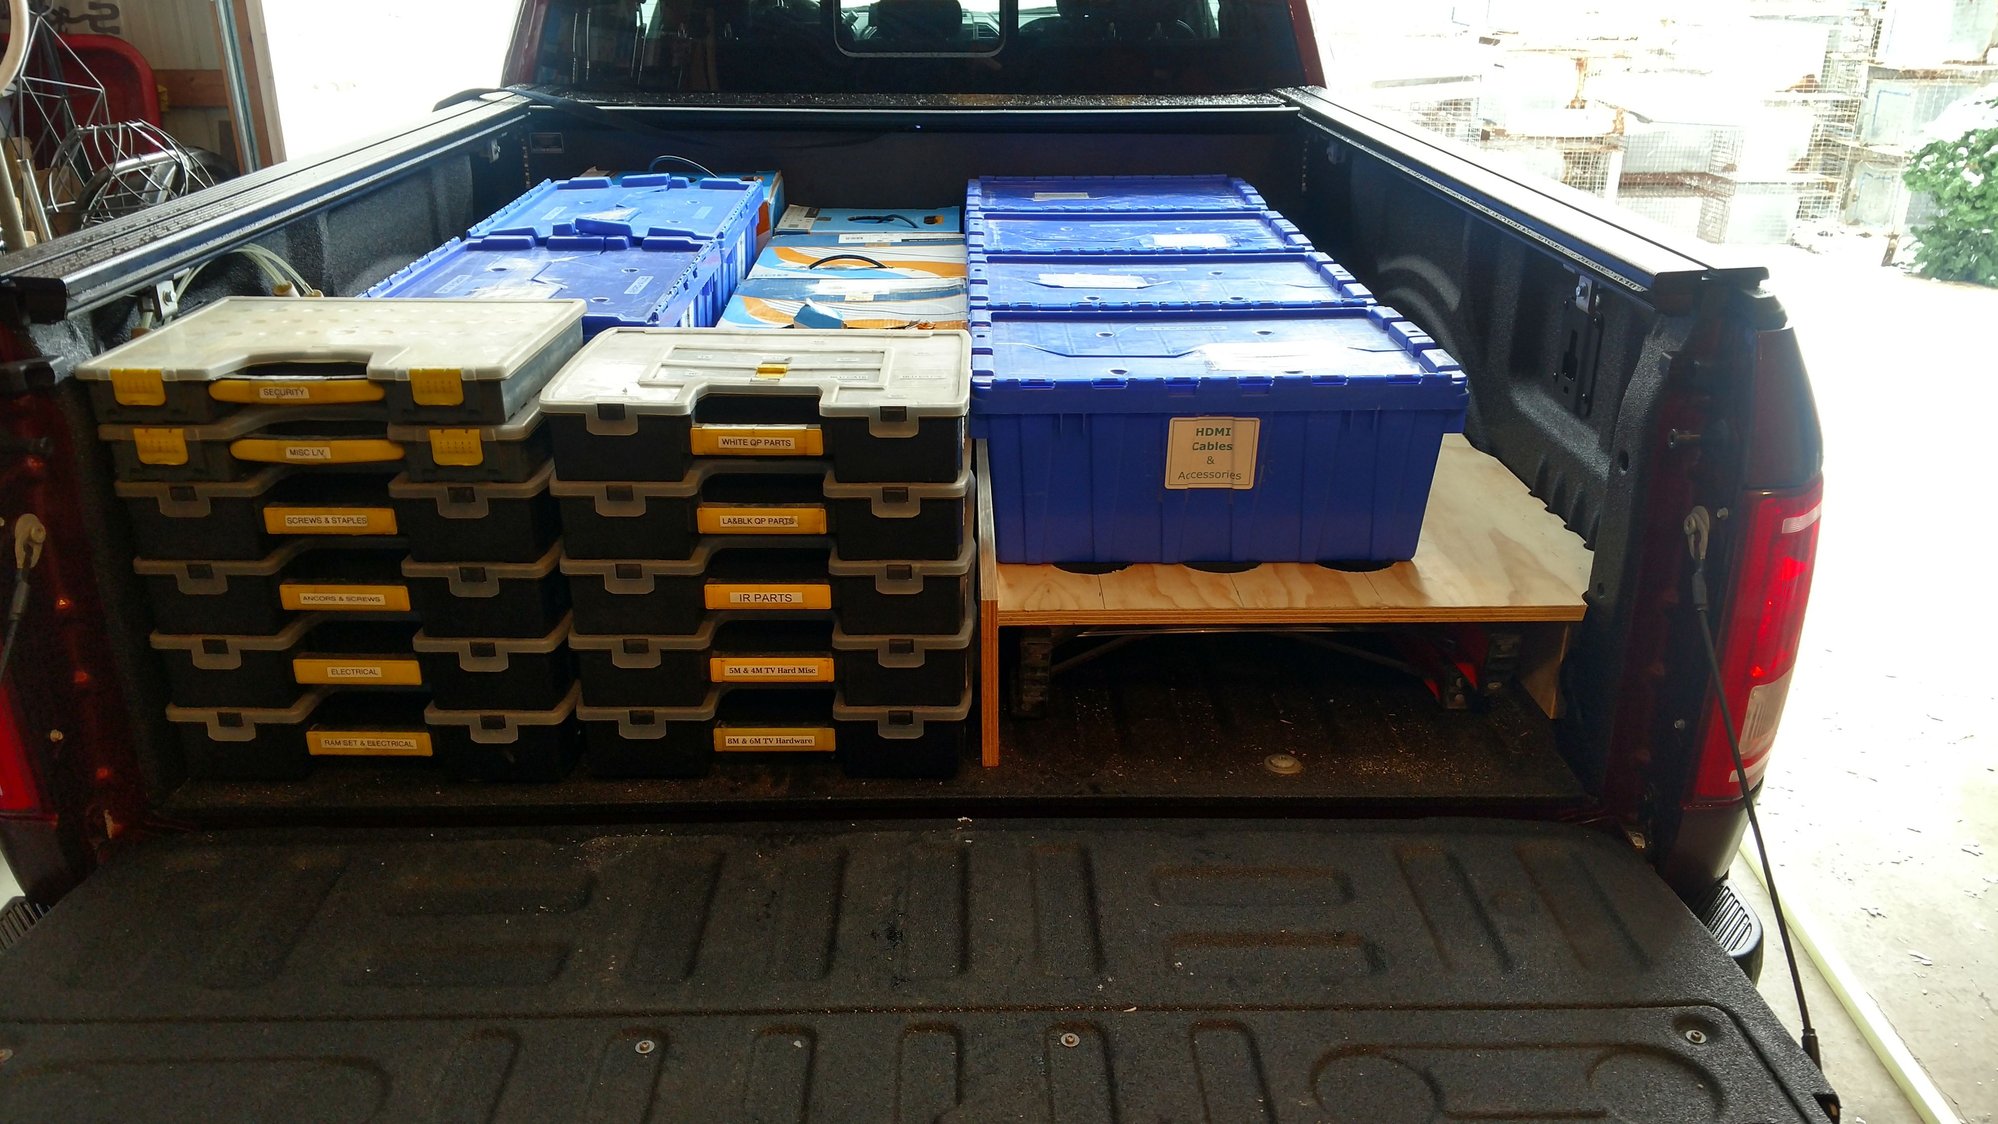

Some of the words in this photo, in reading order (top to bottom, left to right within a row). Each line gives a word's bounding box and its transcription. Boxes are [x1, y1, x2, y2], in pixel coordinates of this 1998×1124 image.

[263, 388, 305, 396] SECURITY
[1195, 427, 1232, 437] HDMI
[721, 438, 748, 446] WHITE
[750, 439, 762, 447] QP
[764, 438, 791, 447] PARTS
[1192, 441, 1233, 451] Cables
[289, 449, 310, 457] MISC
[1206, 455, 1215, 465] &
[1177, 470, 1242, 480] Accessories
[286, 516, 323, 524] SCREWS
[324, 516, 330, 524] &
[331, 516, 368, 525] STAPLES
[722, 517, 753, 525] LA&BLK
[754, 517, 766, 525] QP
[768, 517, 794, 525] PARTS
[739, 593, 751, 602] IR
[754, 593, 793, 602] PARTS
[331, 668, 379, 676] ELECTRICAL
